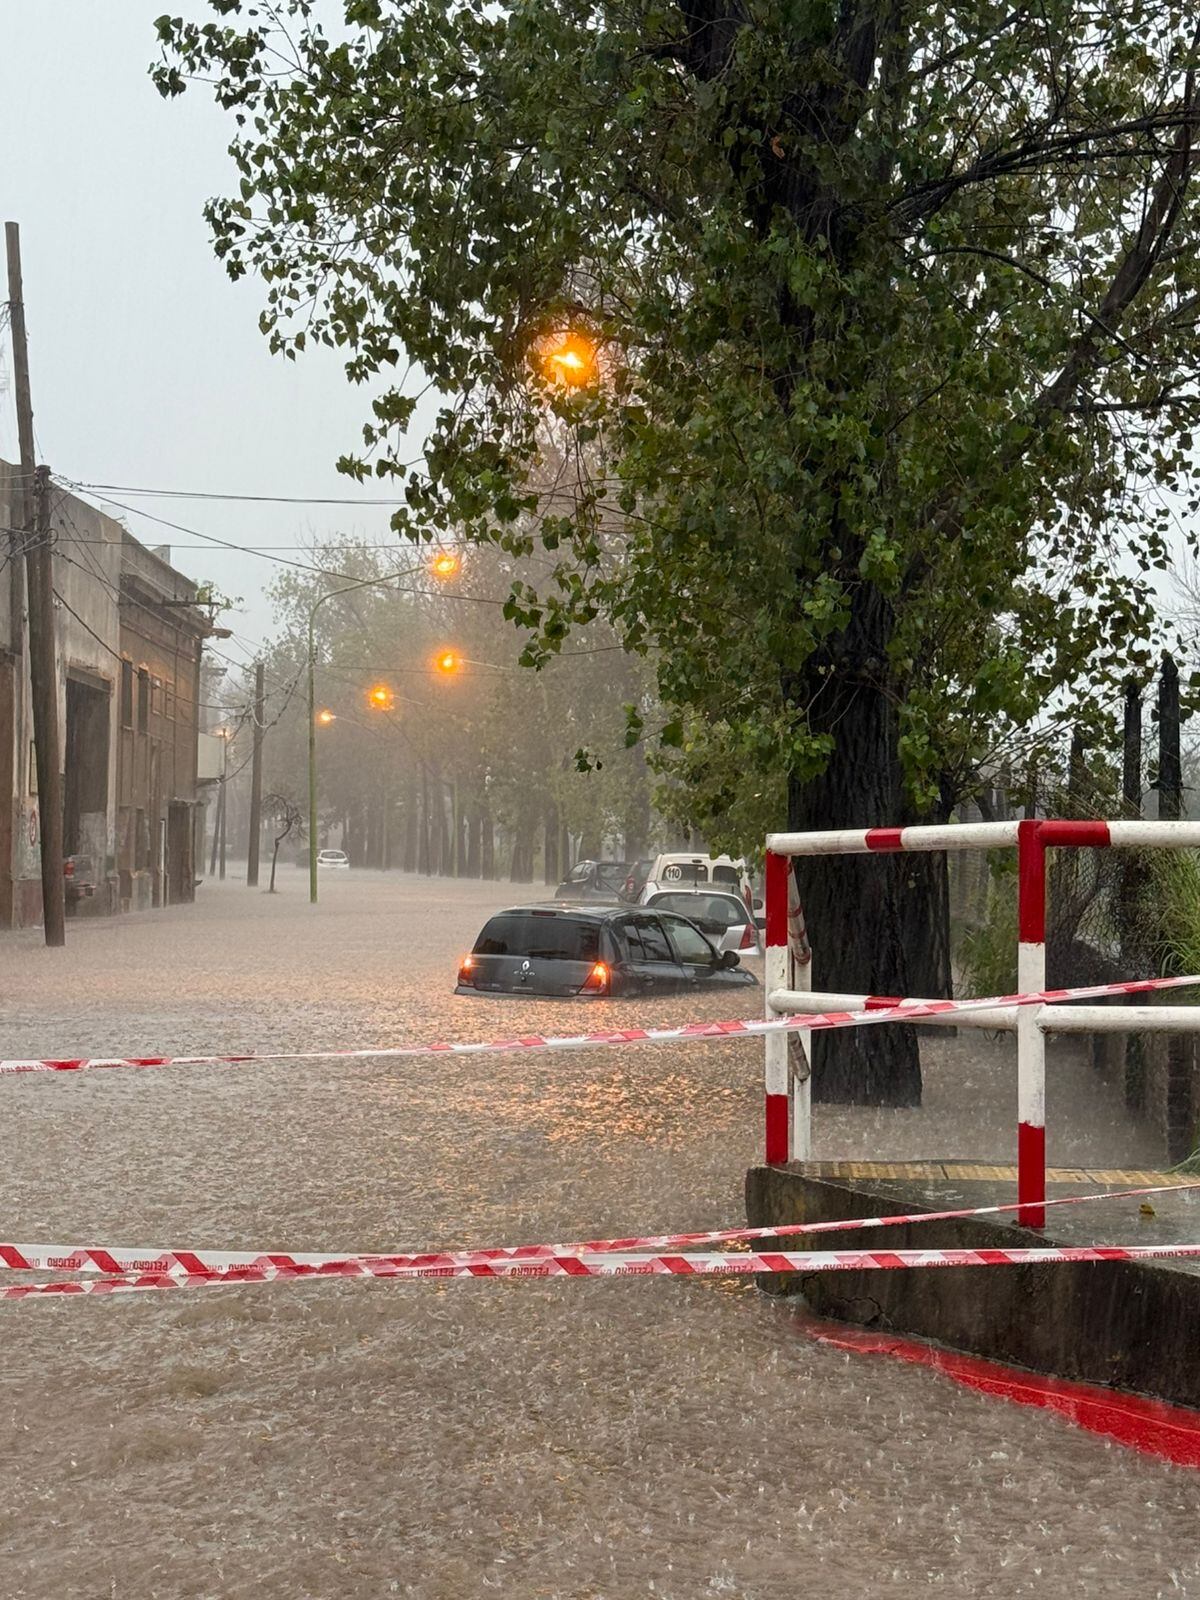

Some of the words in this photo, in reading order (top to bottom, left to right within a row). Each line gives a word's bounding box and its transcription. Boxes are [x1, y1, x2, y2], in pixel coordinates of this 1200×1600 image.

[667, 867, 680, 879] 110
[47, 1257, 82, 1268] PELIGRO
[133, 1259, 169, 1271] PELIGRO
[417, 1268, 454, 1277] PELIGRO
[510, 1267, 549, 1277] PELIGRO
